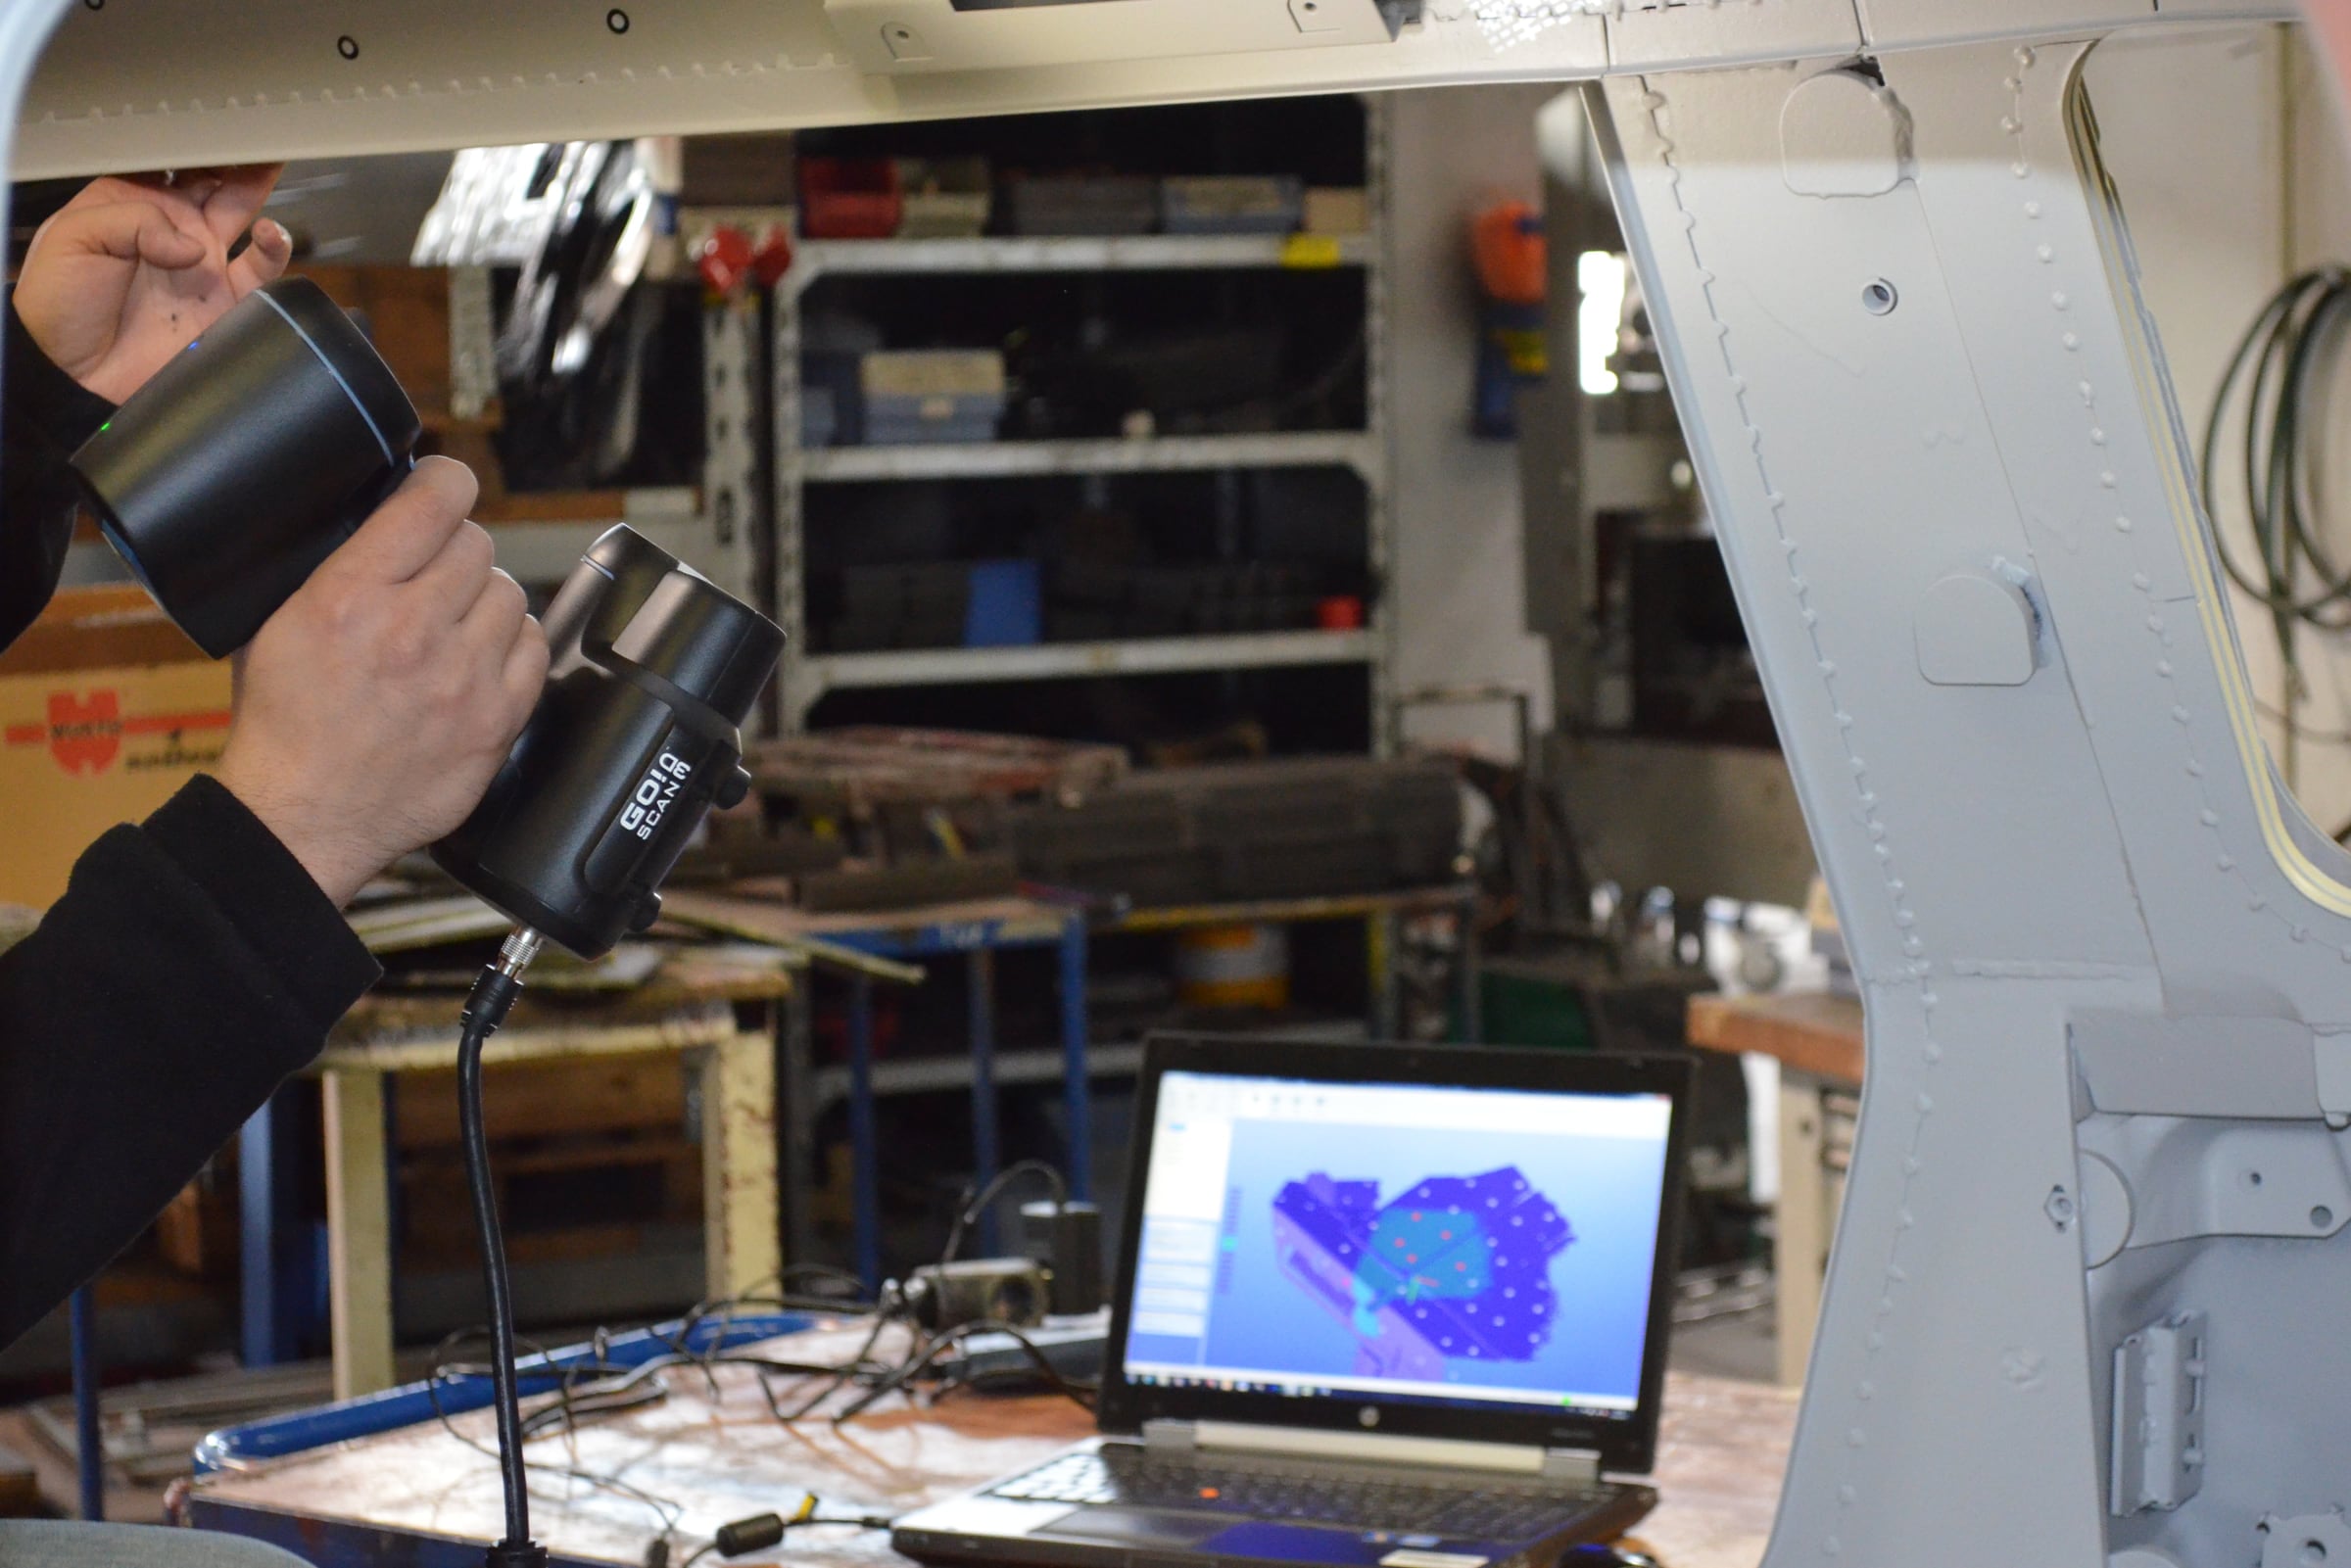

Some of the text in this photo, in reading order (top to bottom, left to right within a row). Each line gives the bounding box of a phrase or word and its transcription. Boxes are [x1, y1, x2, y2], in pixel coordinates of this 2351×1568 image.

[658, 752, 692, 781] 3D
[620, 769, 667, 831] GO!
[637, 781, 681, 840] SCAN
